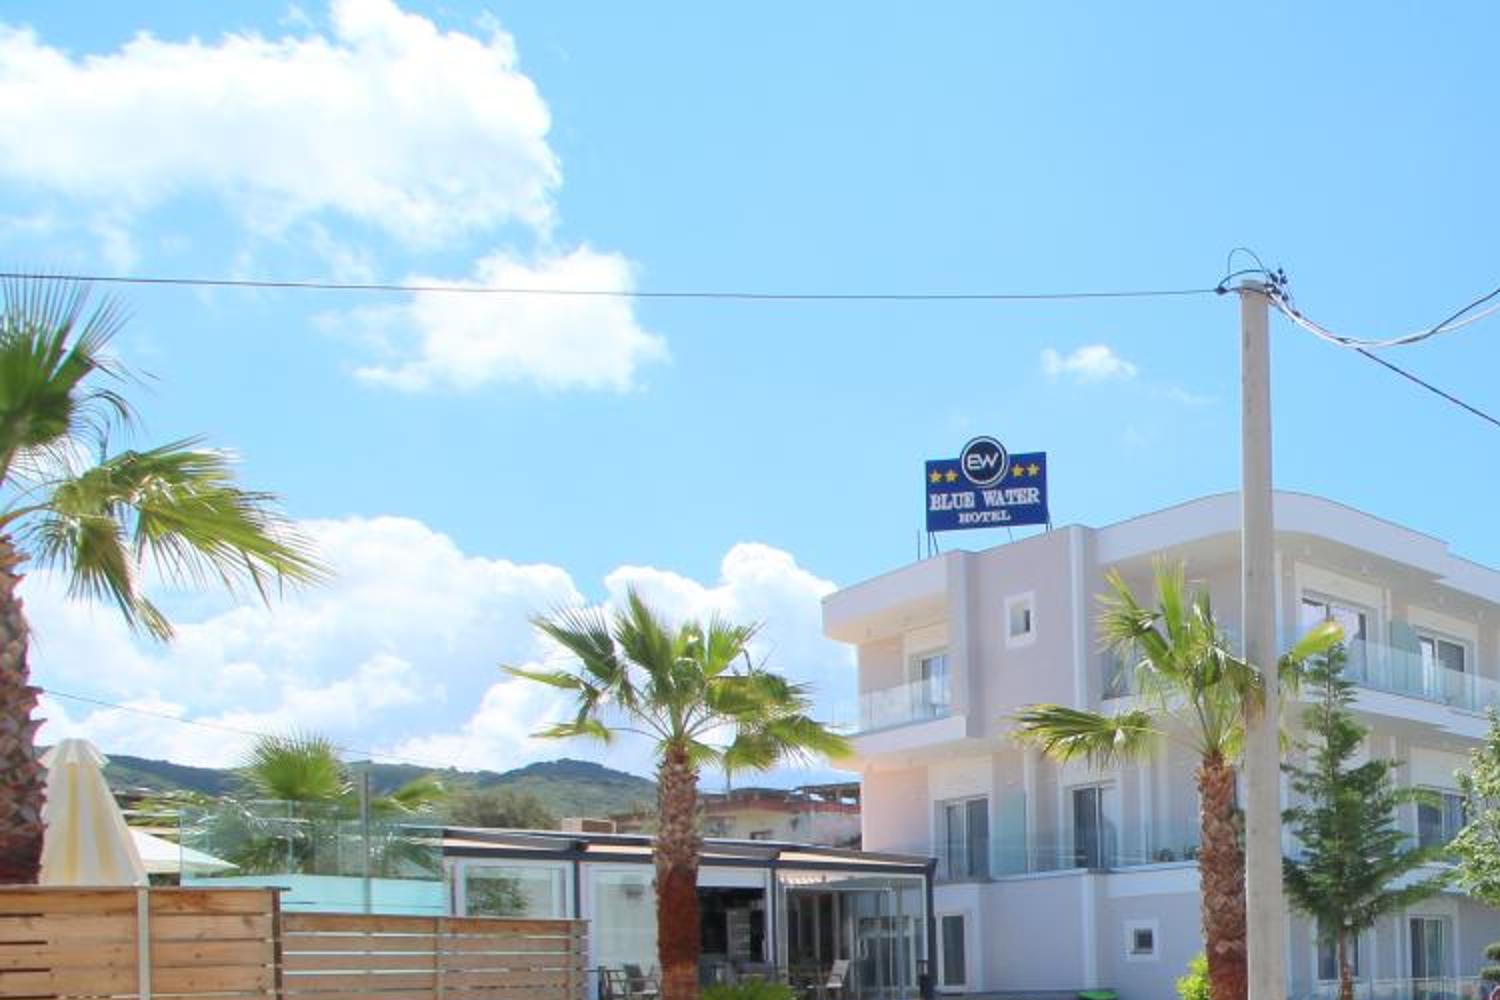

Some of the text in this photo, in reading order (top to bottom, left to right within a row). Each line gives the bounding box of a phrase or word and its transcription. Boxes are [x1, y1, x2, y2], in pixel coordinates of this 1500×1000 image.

[930, 487, 1040, 511] BLUE WATER
[959, 510, 1011, 523] HOTEL
